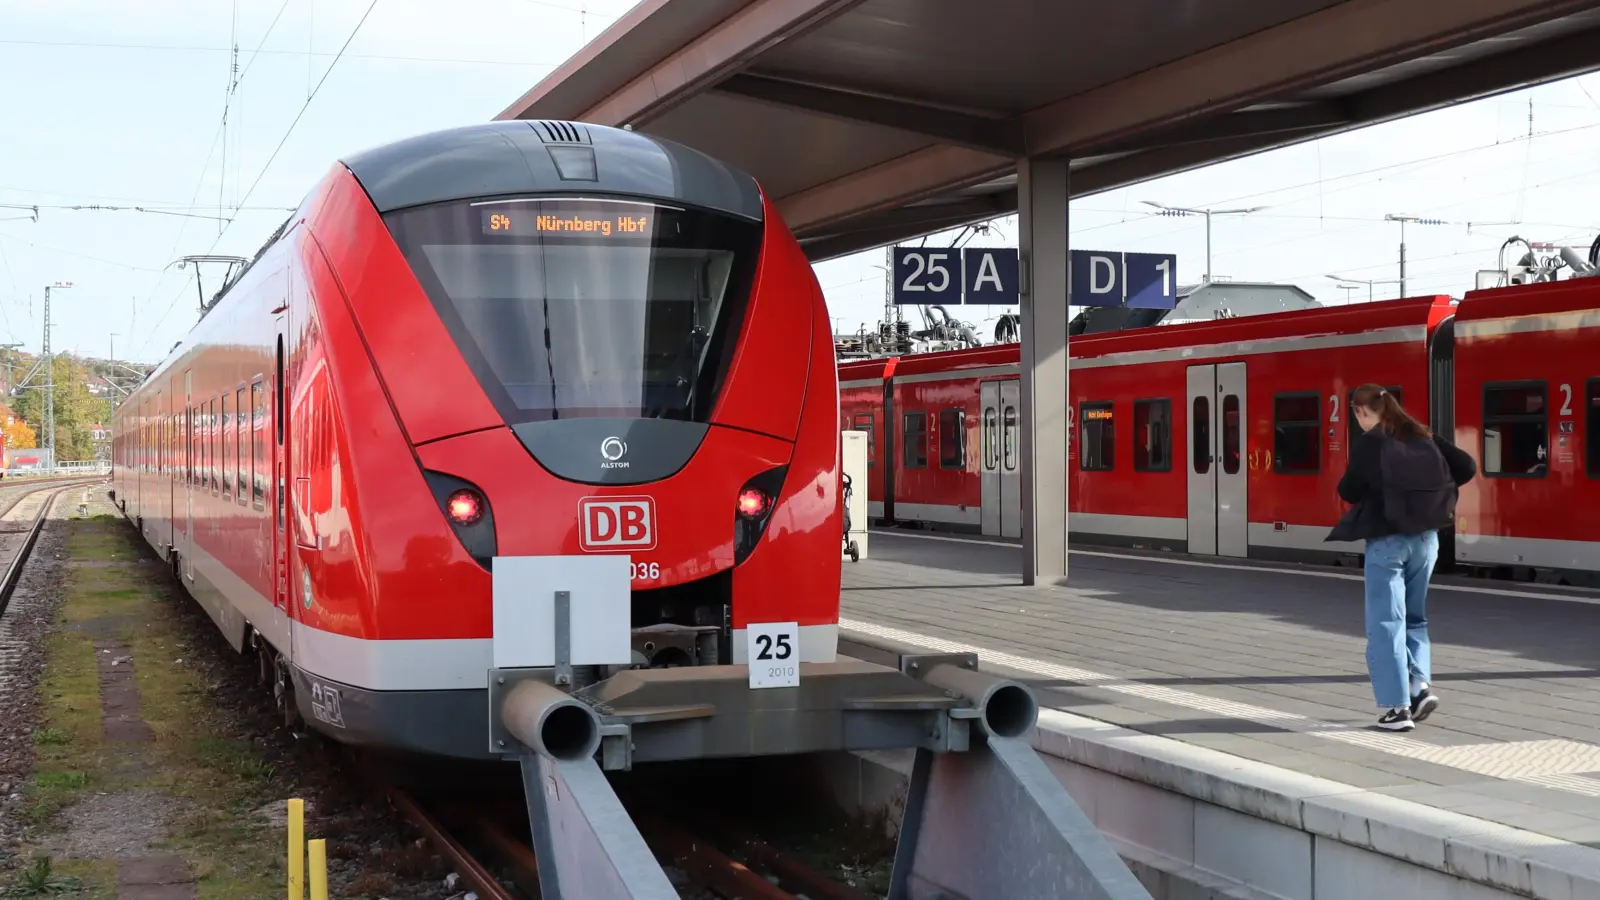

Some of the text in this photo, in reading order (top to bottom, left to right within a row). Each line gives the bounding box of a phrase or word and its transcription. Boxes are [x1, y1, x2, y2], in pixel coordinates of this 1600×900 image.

[489, 214, 647, 236] S4 Nürnberg Hbf
[901, 252, 1170, 297] 25 A D 1
[1329, 394, 1340, 422] 2
[1559, 383, 1573, 416] 2
[930, 412, 936, 432] 2
[589, 505, 647, 542] DB
[755, 633, 792, 660] 25
[768, 666, 795, 678] 2010
